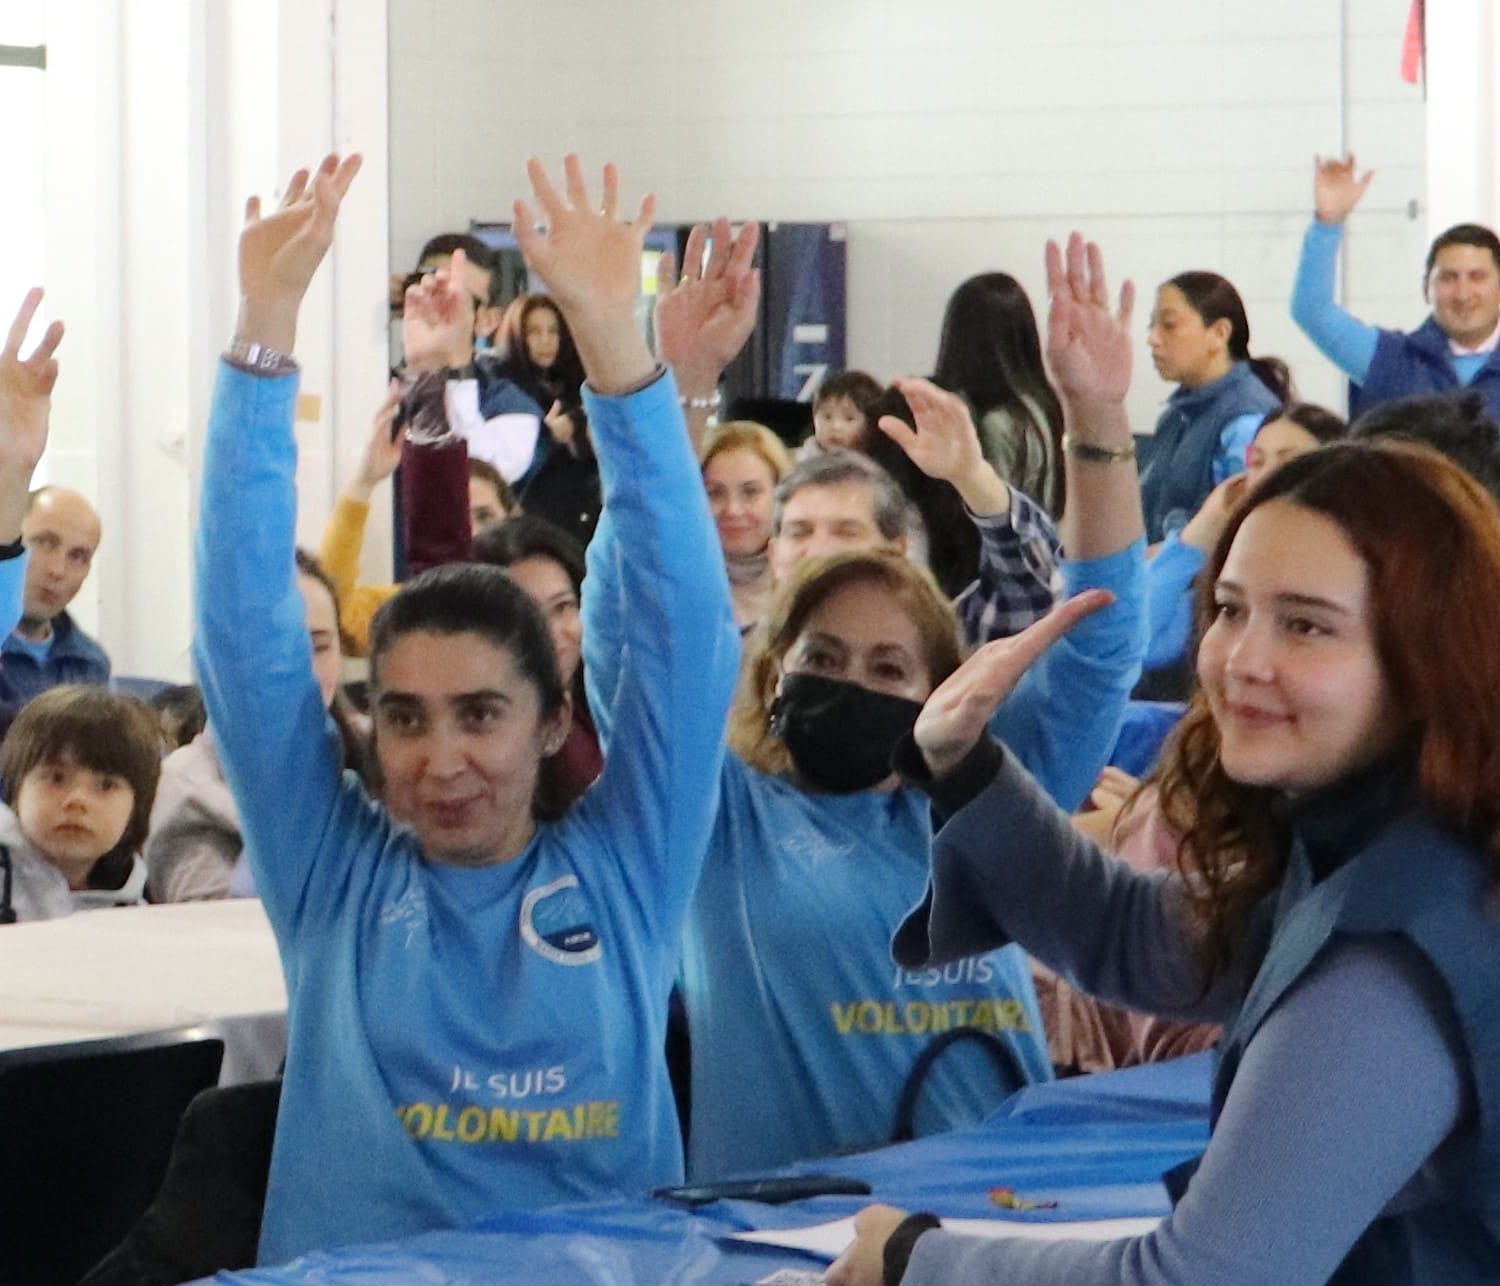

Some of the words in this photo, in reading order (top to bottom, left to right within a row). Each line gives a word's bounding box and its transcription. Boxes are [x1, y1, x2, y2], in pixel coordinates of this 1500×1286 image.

[452, 1066, 479, 1093] JE
[487, 1065, 567, 1098] SUIS
[395, 1101, 620, 1143] OLONTAIRE
